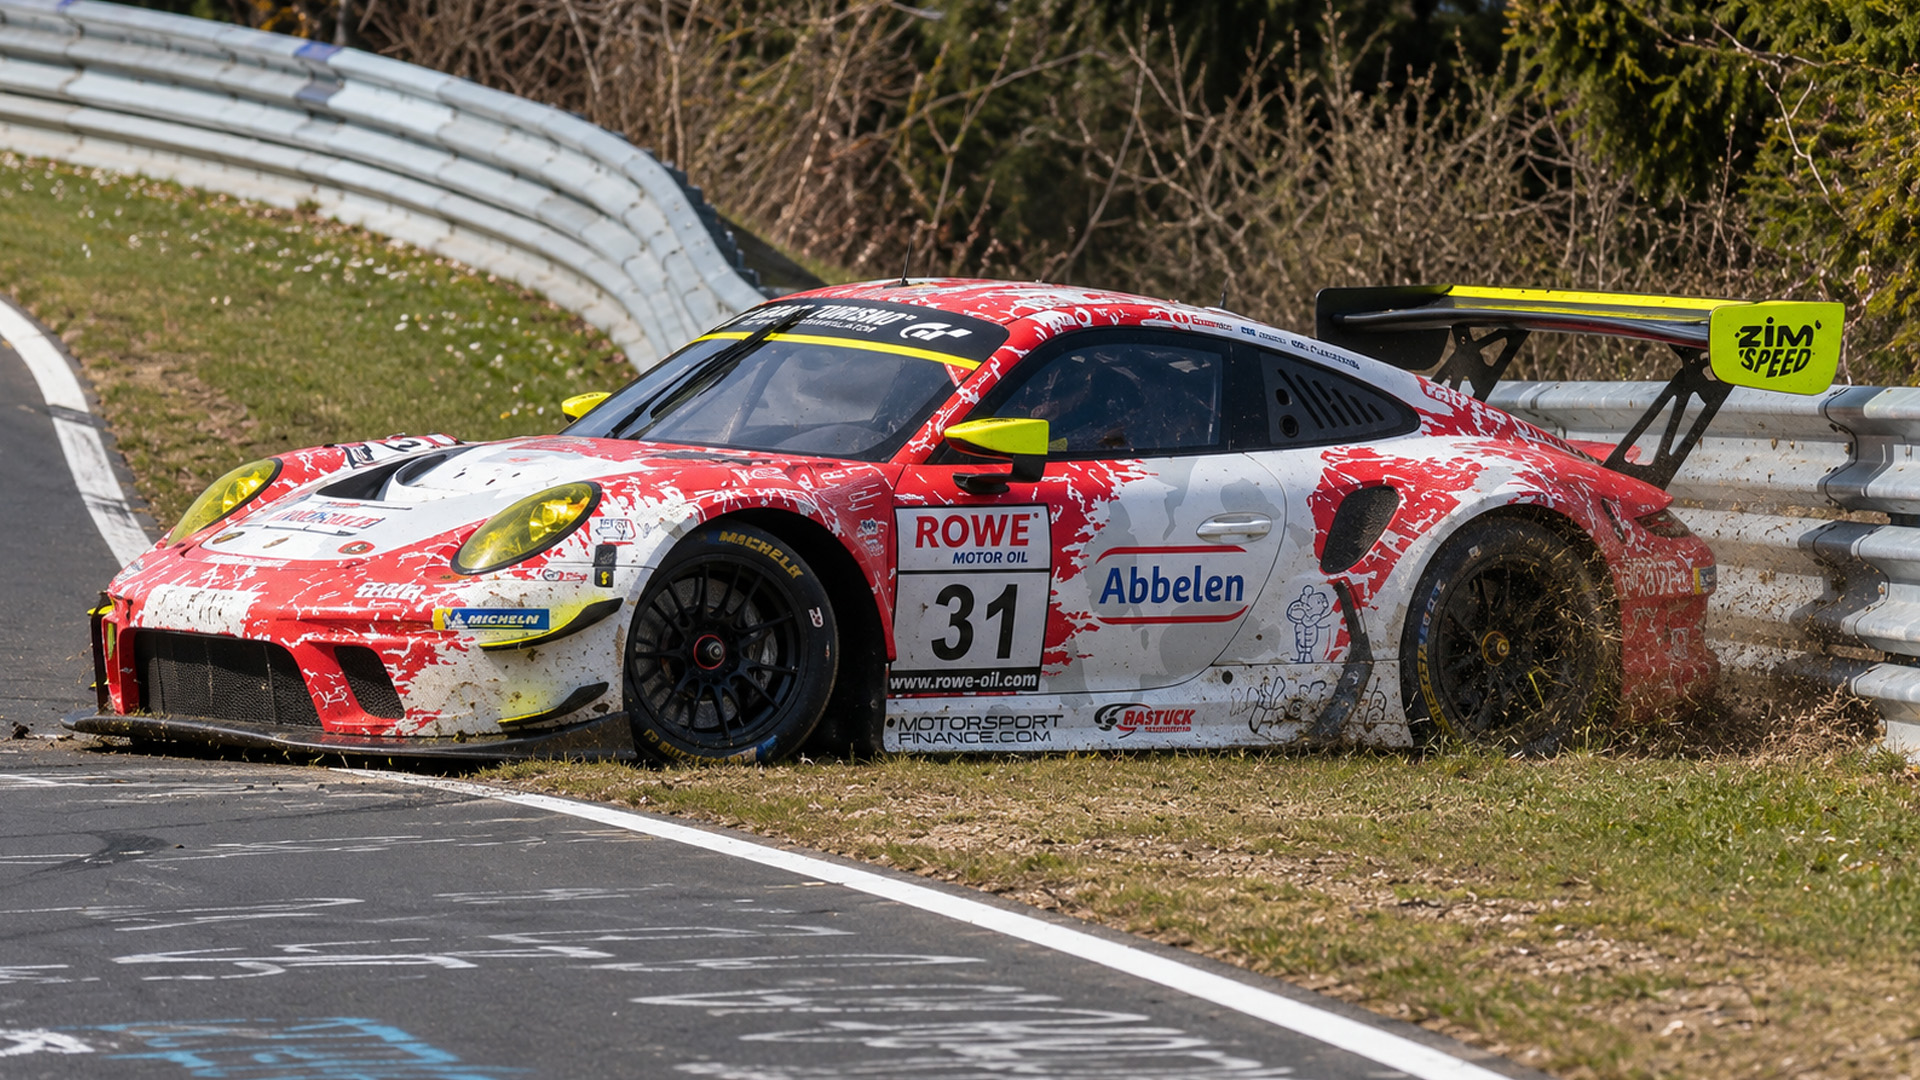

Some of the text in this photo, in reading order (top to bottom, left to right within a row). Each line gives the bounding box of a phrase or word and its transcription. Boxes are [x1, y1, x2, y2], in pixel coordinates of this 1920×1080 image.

[1739, 348, 1812, 378] SPEED
[915, 513, 1031, 548] ROWE
[952, 551, 1028, 564] MOTOR OIL
[1099, 565, 1244, 604] Abbelen
[931, 584, 1017, 661] 31
[890, 672, 1037, 689] www.rowe-oil.com
[898, 714, 1064, 731] MOTORSPORT
[898, 731, 1052, 744] FINANCE.COM
